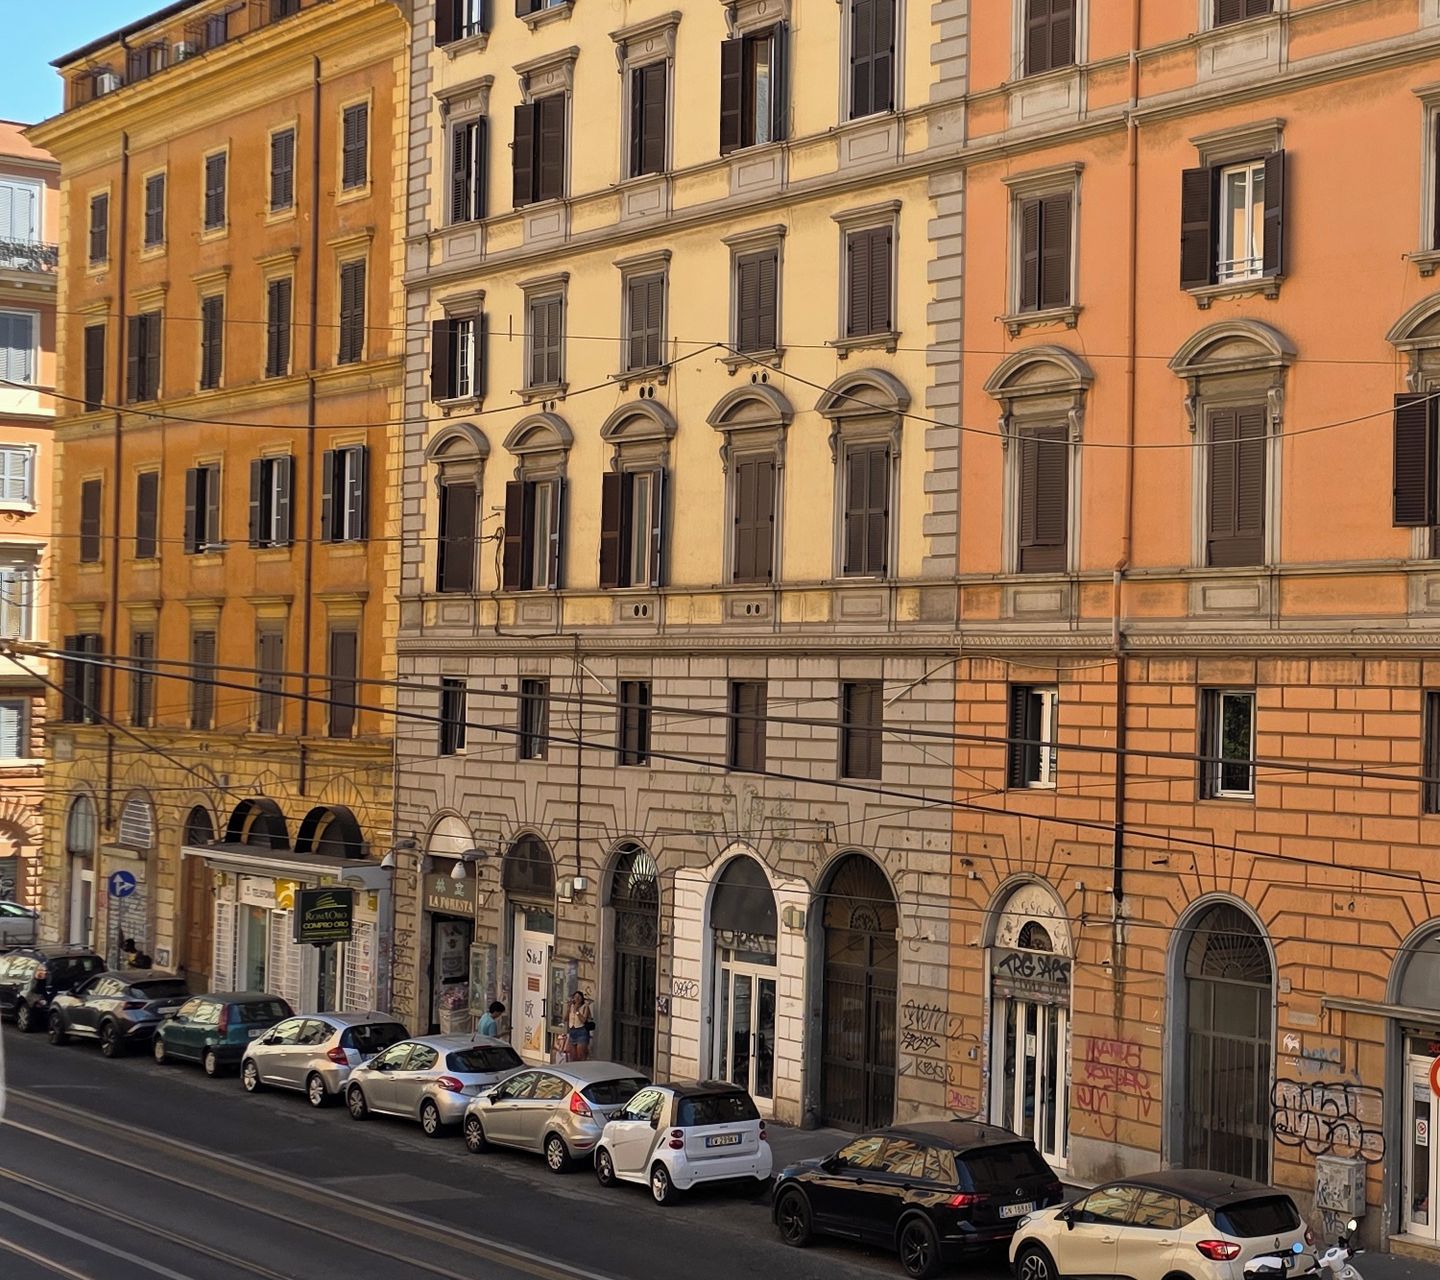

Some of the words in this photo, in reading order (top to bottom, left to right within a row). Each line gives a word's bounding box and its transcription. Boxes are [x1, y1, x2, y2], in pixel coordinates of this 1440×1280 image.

[428, 894, 438, 907] LA
[440, 897, 474, 913] FORESTA
[526, 948, 543, 965] S&J
